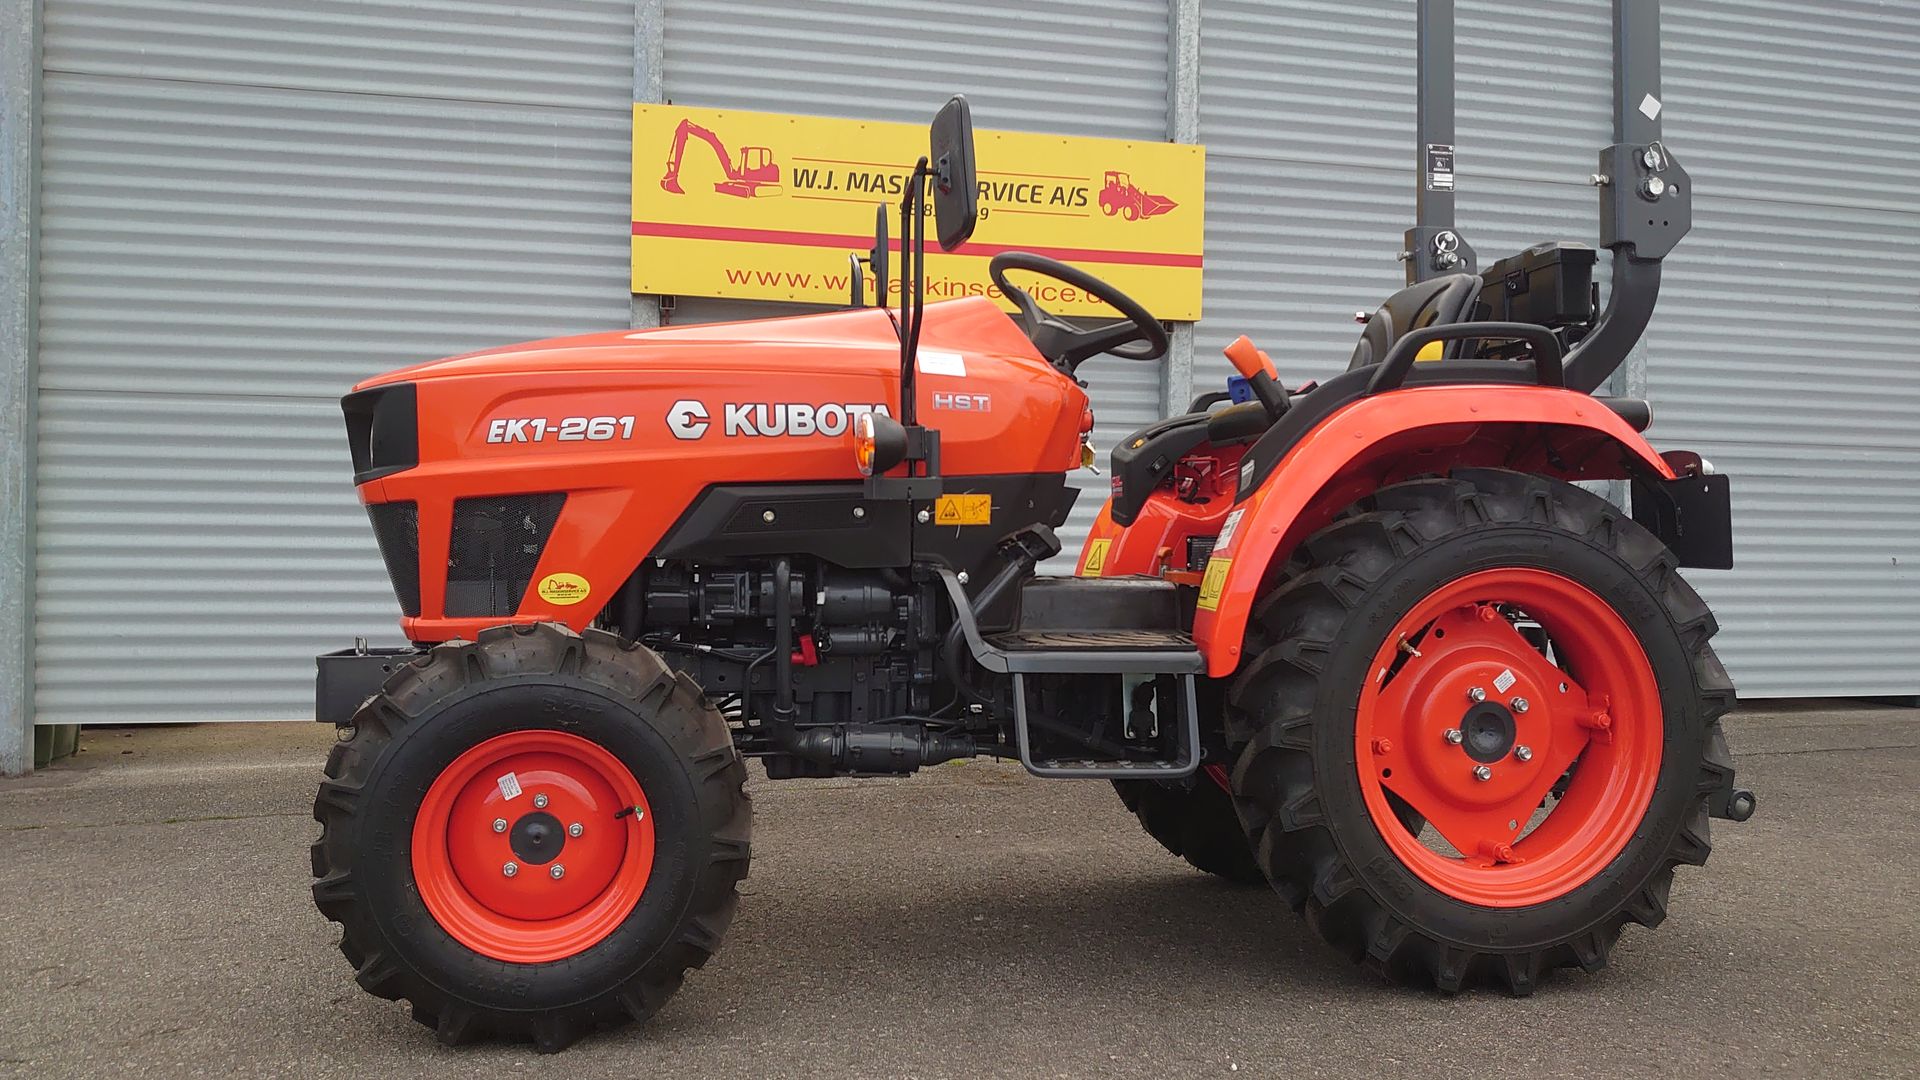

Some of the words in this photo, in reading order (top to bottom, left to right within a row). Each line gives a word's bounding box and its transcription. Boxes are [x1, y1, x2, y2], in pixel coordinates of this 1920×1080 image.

[793, 167, 838, 191] W.J.
[1049, 186, 1089, 207] A/S
[934, 393, 989, 411] HST
[486, 415, 636, 443] EK1-261
